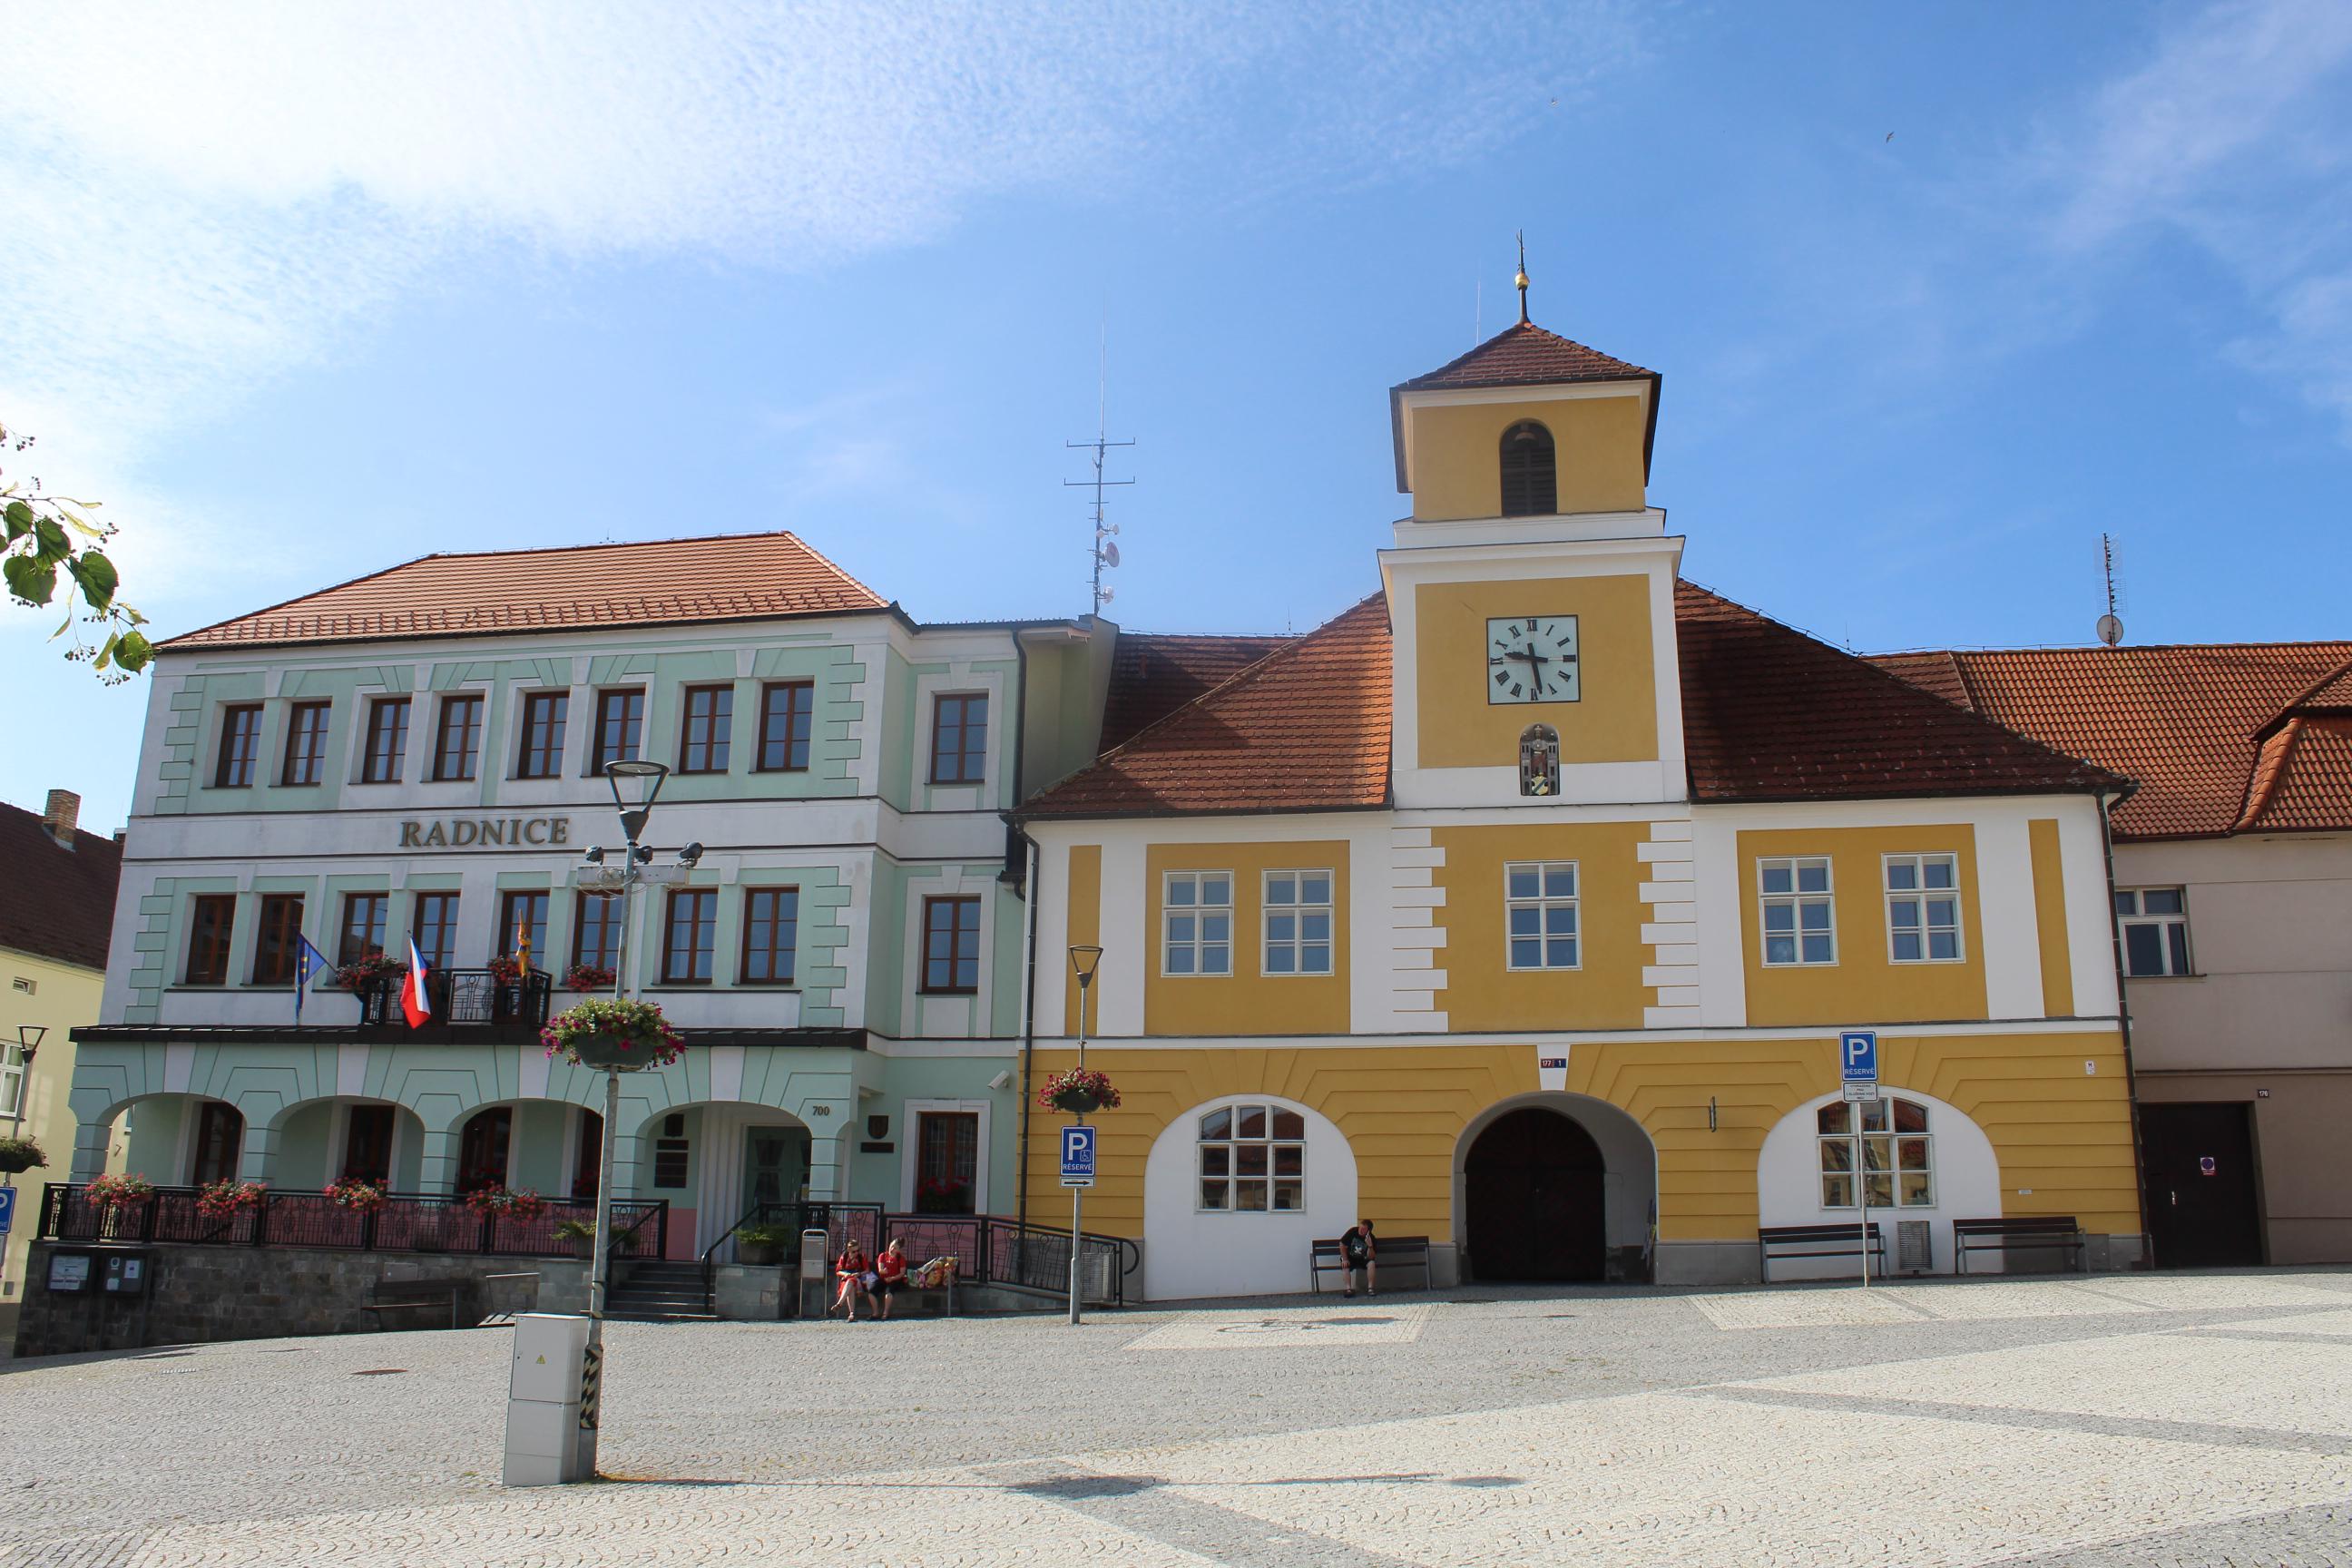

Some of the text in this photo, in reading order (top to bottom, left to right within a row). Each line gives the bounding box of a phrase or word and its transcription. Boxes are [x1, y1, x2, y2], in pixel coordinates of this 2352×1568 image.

[1526, 619, 1538, 632] XII
[1545, 624, 1554, 636] I
[1508, 625, 1522, 639] XI
[1494, 639, 1508, 650] X
[1556, 637, 1571, 648] II
[1490, 657, 1504, 666] IX
[1563, 654, 1576, 662] III
[1557, 670, 1572, 682] IV
[1547, 682, 1558, 695] V
[398, 818, 569, 848] RADNICE
[1848, 1038, 1868, 1065] P
[1542, 1059, 1552, 1067] 177
[812, 1105, 830, 1116] 700
[1068, 1132, 1088, 1161] P
